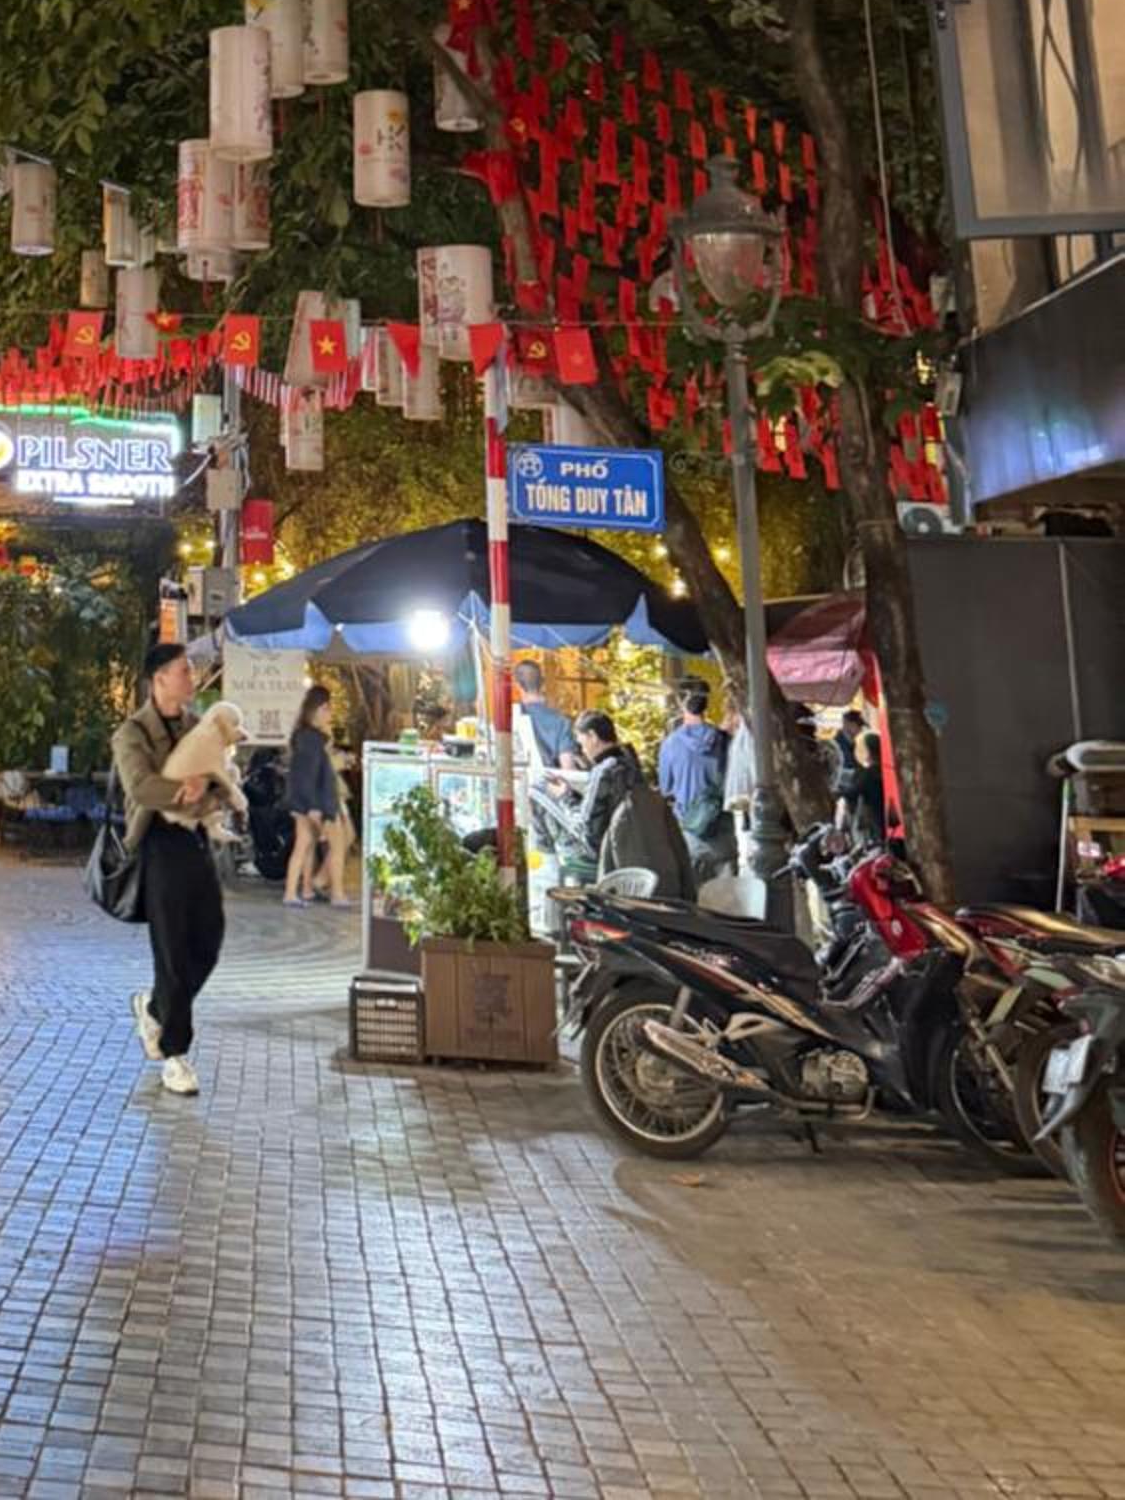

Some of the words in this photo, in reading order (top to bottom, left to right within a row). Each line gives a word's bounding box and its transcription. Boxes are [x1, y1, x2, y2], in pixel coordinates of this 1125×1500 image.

[16, 435, 172, 473] PILSNER
[559, 458, 610, 480] PHỐ
[525, 475, 572, 513] TỐNG
[575, 486, 609, 515] DUY
[612, 483, 648, 517] TÂN
